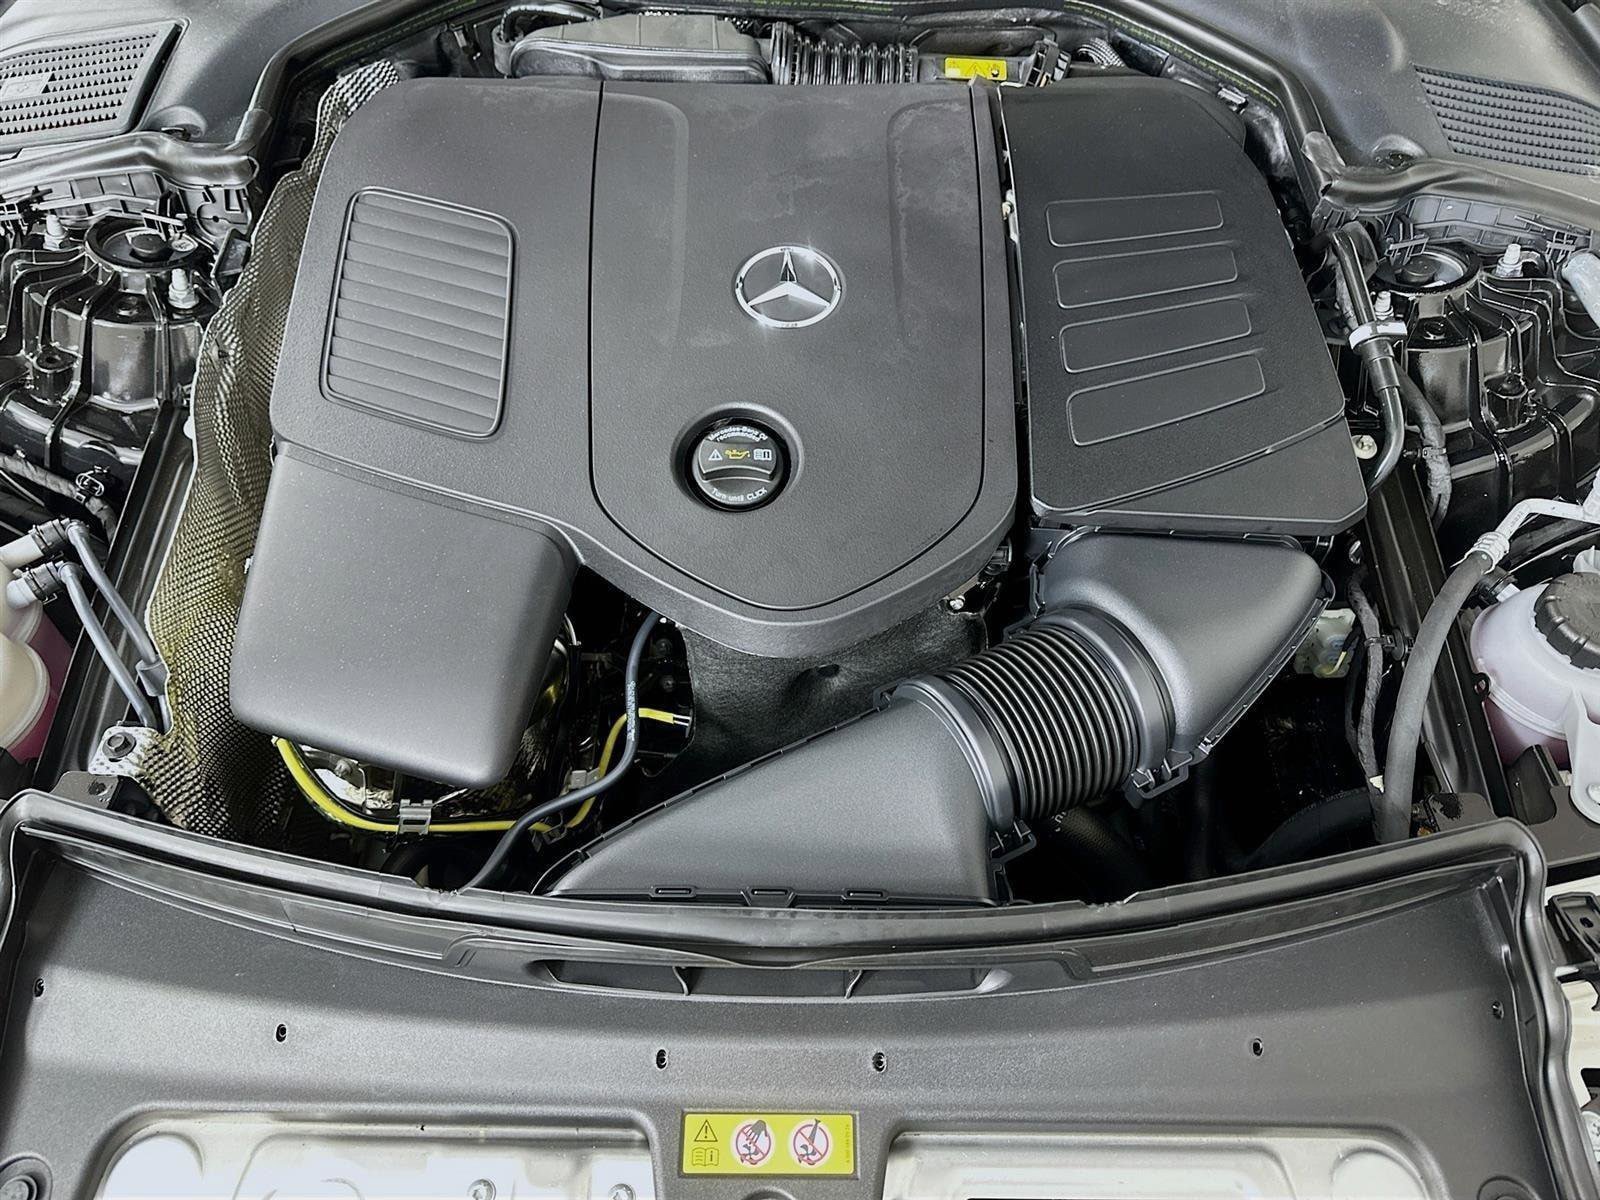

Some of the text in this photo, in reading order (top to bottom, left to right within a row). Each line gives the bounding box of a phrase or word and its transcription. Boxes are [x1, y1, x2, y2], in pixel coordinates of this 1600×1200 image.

[708, 426, 759, 441] Mercedes-Benz
[717, 432, 760, 442] recommended
[712, 487, 727, 500] Turn
[747, 487, 768, 500] CLICK
